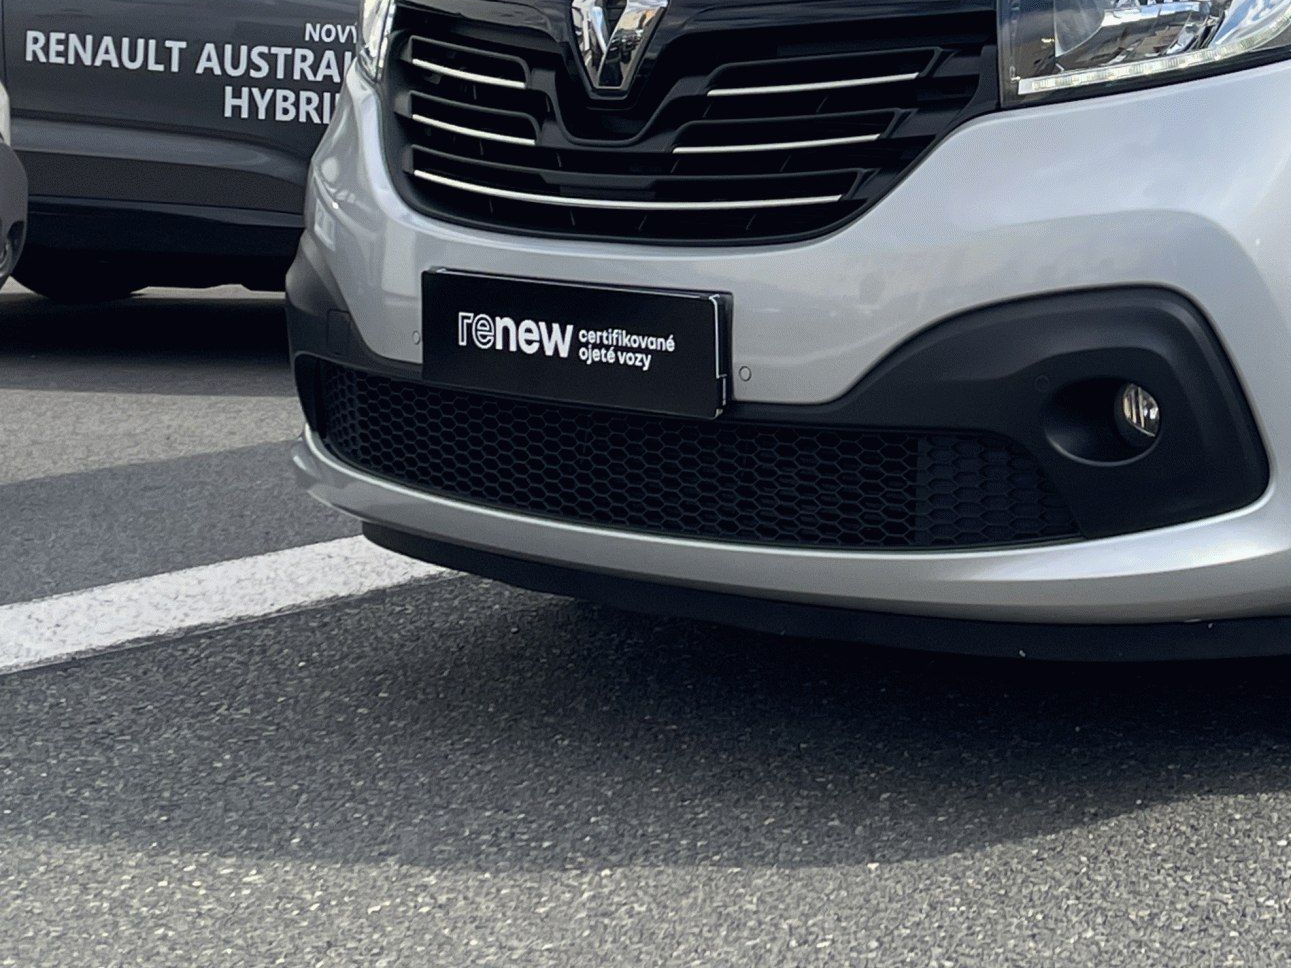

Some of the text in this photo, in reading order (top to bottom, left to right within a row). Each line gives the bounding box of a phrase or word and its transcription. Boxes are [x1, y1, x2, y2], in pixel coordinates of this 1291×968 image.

[25, 30, 187, 73] RENAULT
[223, 85, 341, 125] HYBRI
[458, 311, 676, 359] renew certifikované
[578, 345, 652, 371] ojeté vozy
